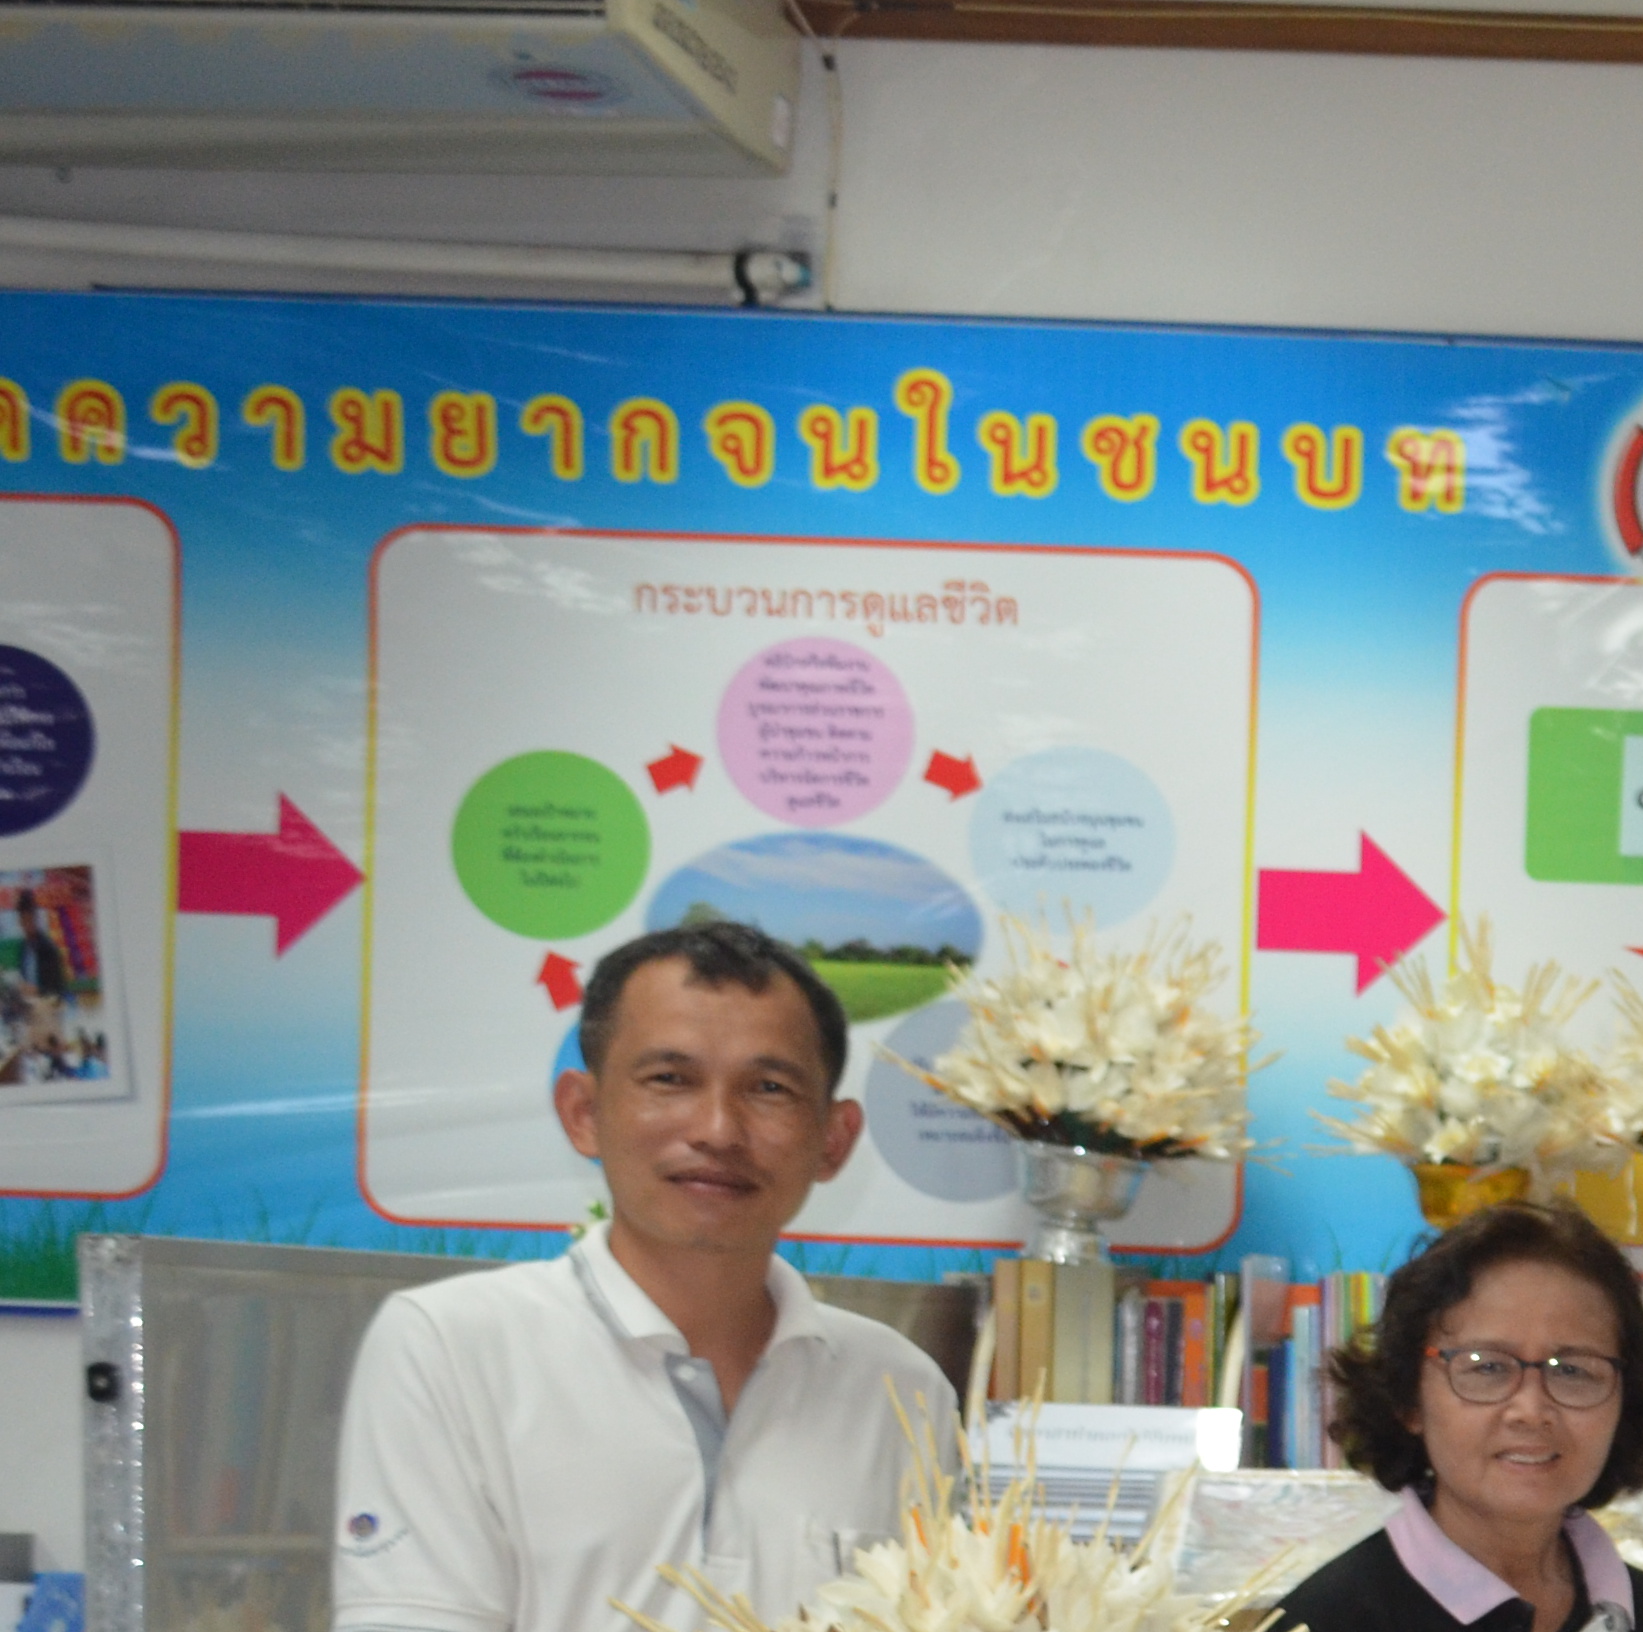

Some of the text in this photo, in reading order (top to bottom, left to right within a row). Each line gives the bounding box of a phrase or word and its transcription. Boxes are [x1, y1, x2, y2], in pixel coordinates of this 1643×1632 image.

[632, 578, 1020, 638] กระบวนการดูแลชีวิต
